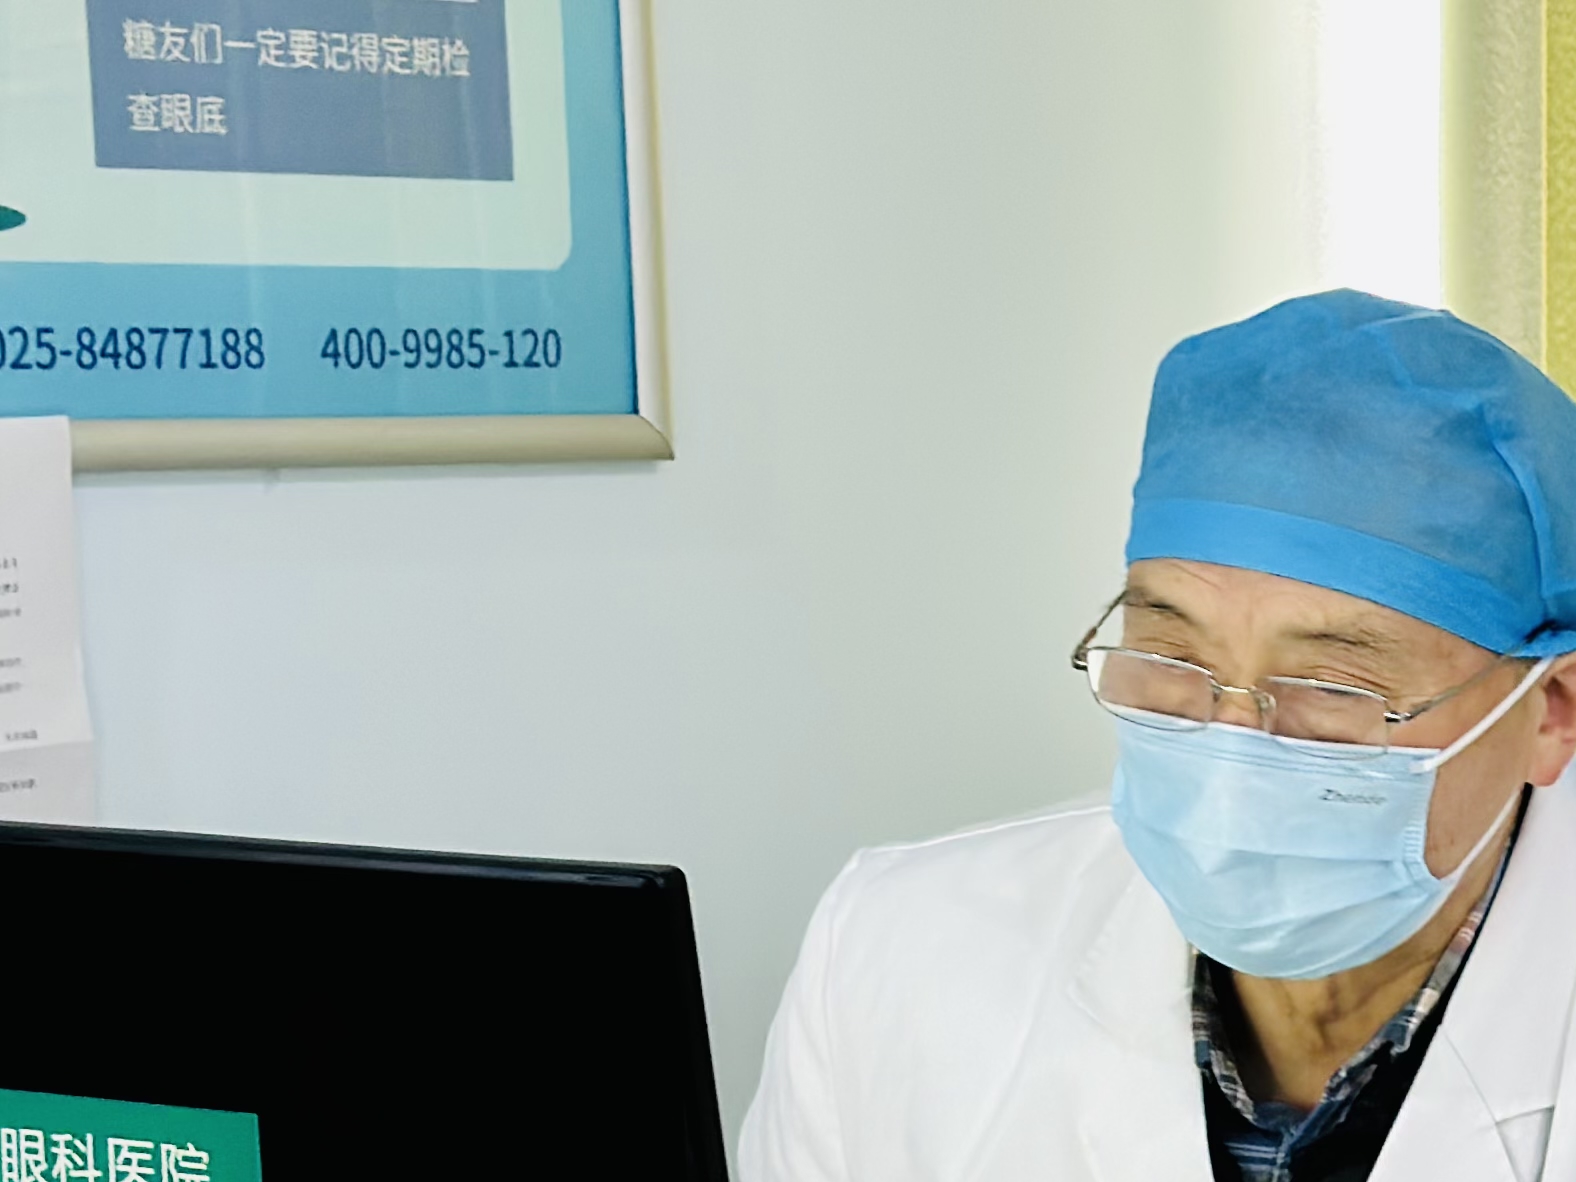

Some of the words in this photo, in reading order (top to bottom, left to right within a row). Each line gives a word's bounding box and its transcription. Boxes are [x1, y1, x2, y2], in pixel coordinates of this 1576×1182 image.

[121, 18, 471, 77] 糖友们一定要记得定期检
[126, 93, 228, 136] 查眼底
[320, 327, 562, 369] 400-9985-120
